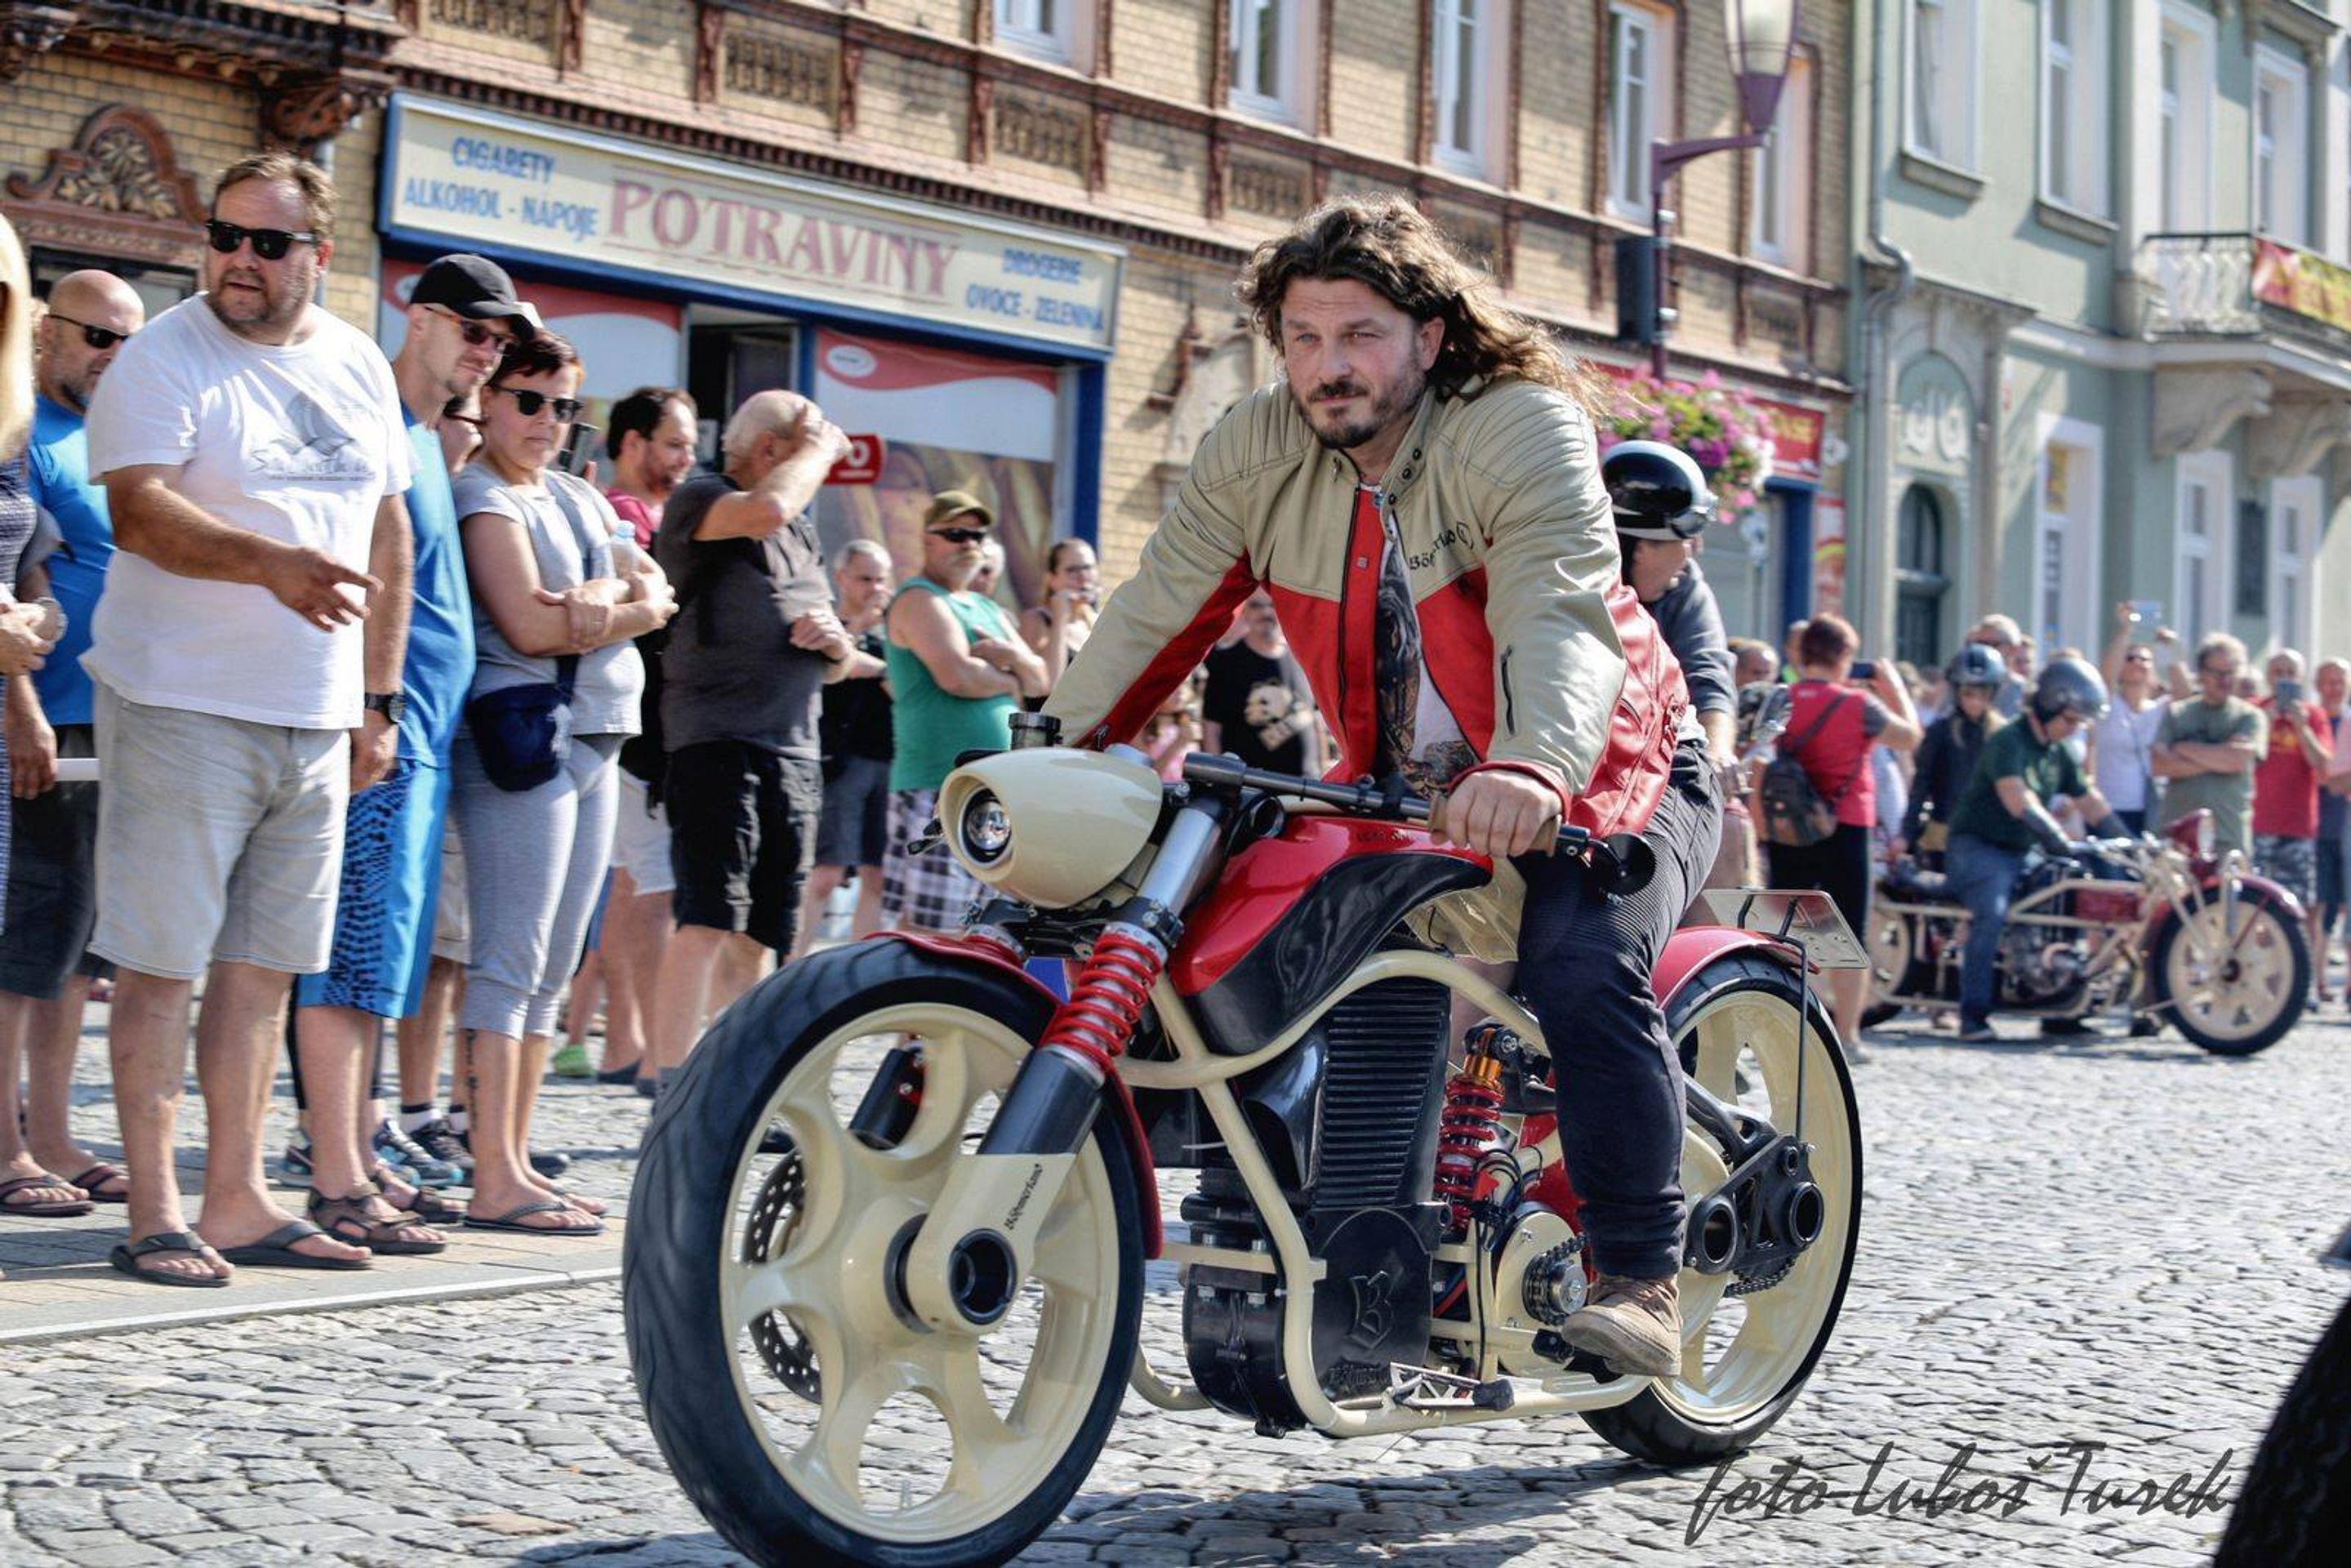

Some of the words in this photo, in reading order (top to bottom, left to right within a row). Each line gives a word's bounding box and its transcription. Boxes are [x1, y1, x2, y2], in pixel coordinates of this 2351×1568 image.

[452, 136, 554, 184] CIGARETY
[404, 177, 503, 220] ALKOHOL
[522, 196, 599, 242] NAPOJE
[608, 177, 960, 297] POTRAVINY
